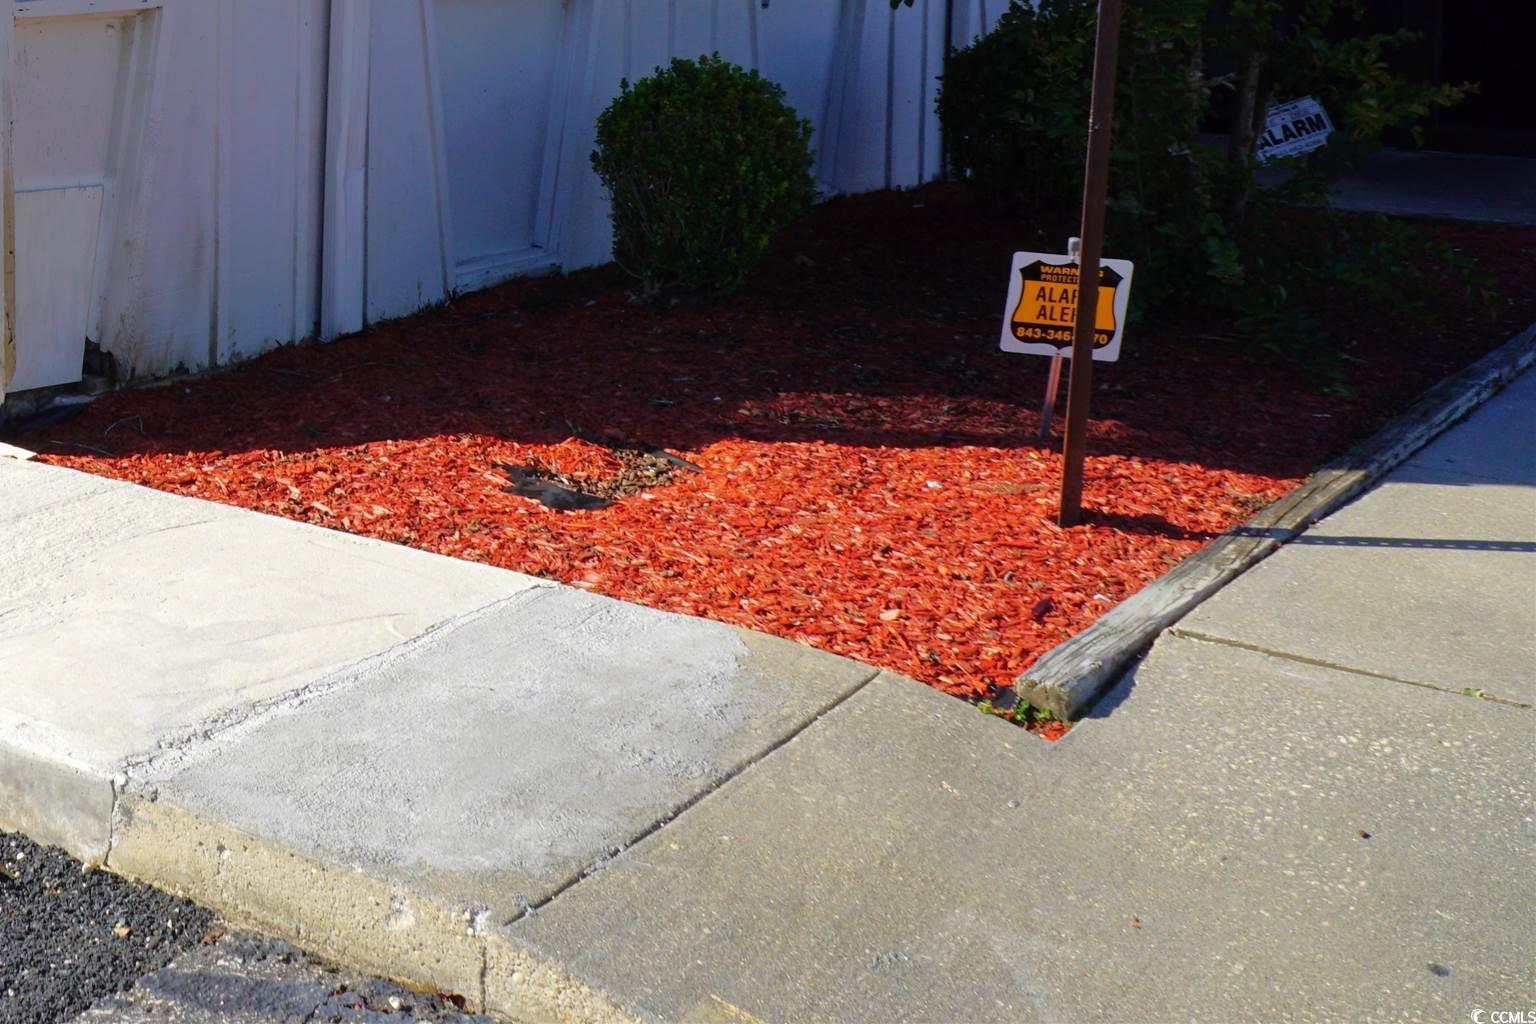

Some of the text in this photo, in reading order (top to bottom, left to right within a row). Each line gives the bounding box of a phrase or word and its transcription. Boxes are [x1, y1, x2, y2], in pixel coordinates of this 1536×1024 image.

[1260, 113, 1327, 150] ALARM
[1036, 286, 1078, 305] ALA
[1036, 305, 1077, 323] ALE
